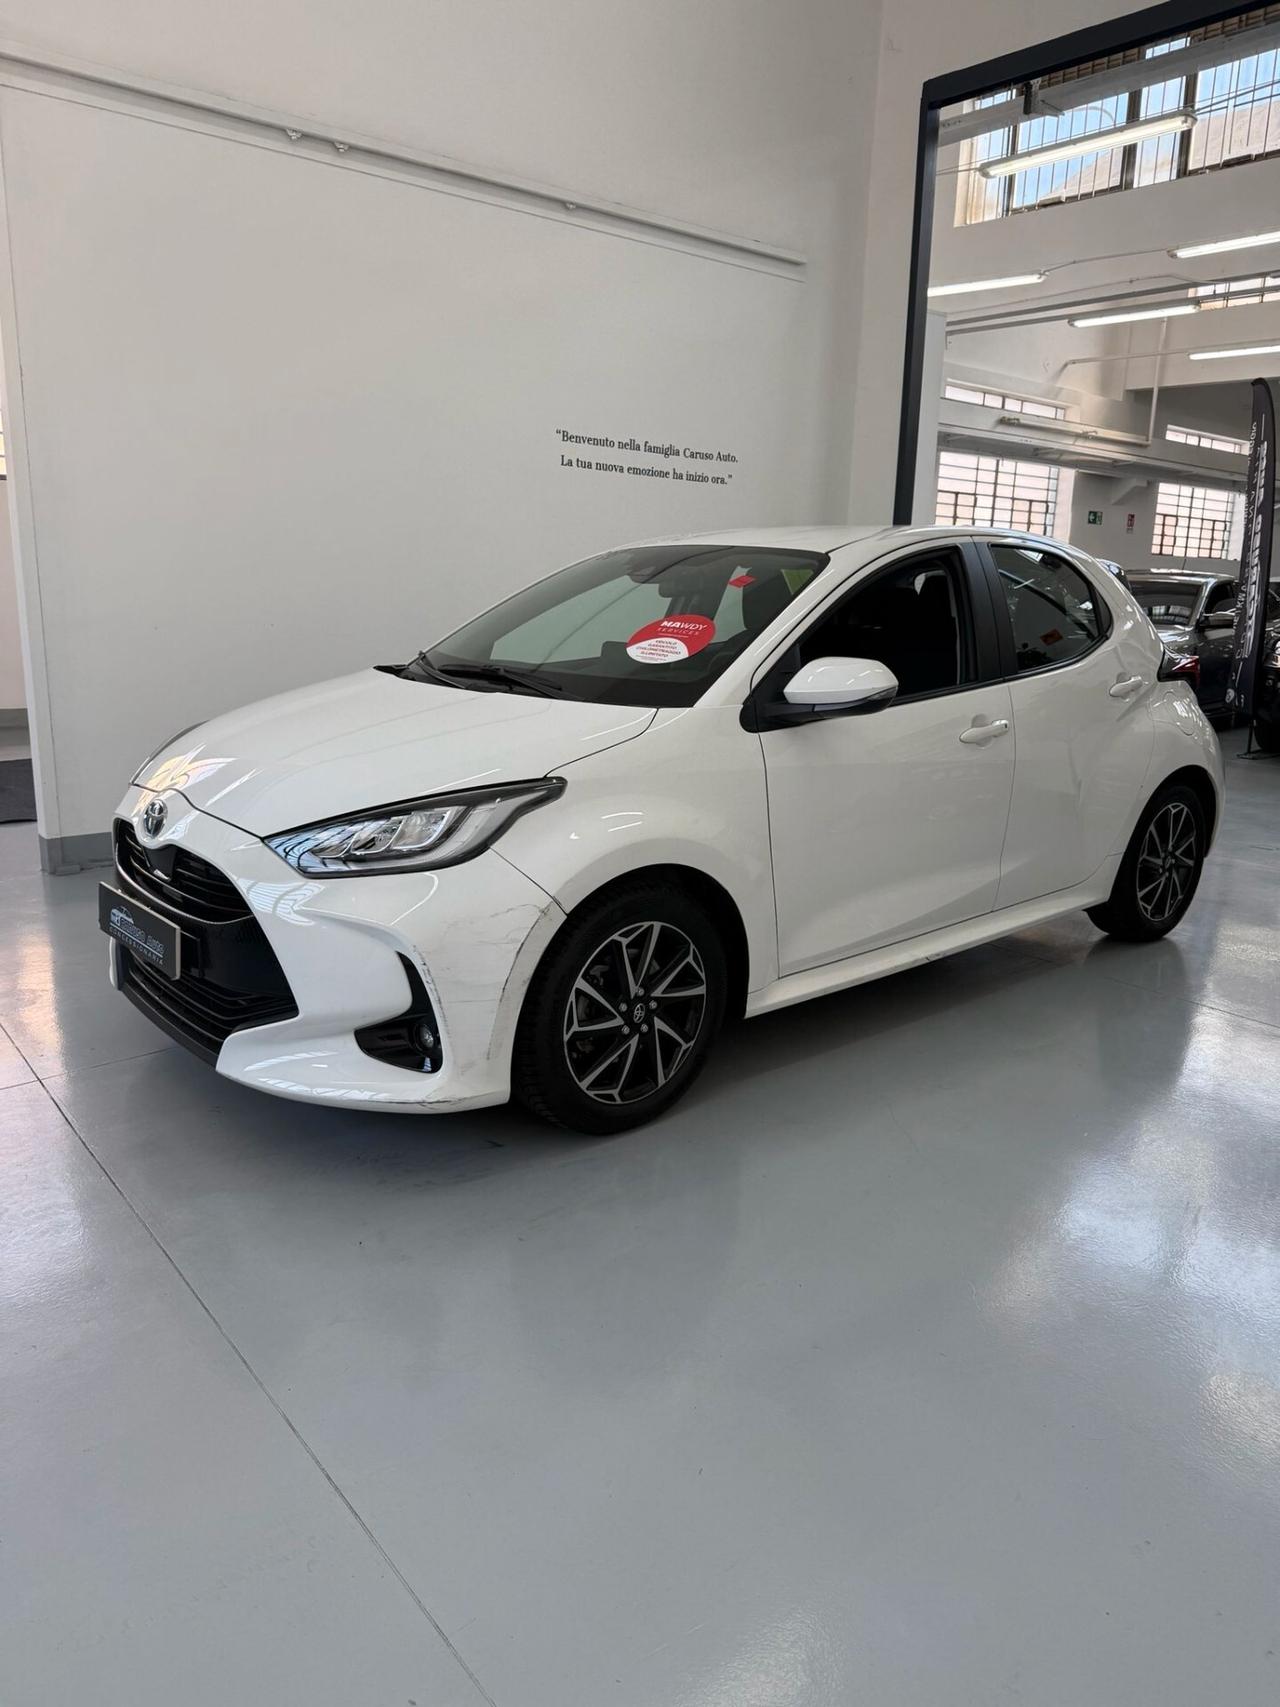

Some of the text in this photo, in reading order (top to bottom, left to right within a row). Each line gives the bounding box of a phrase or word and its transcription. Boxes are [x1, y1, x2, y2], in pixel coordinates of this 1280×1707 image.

[617, 438, 641, 451] nella
[643, 441, 680, 458] famiglia
[683, 448, 714, 461] Caruso
[715, 451, 739, 463] Auto.
[560, 454, 573, 467] La
[576, 458, 592, 469] tua
[595, 462, 624, 474] nuova
[627, 466, 670, 479] emozione
[672, 468, 684, 480] ha
[685, 471, 709, 483] inizio
[656, 627, 699, 635] SERVICES
[660, 621, 707, 630] MAWDY
